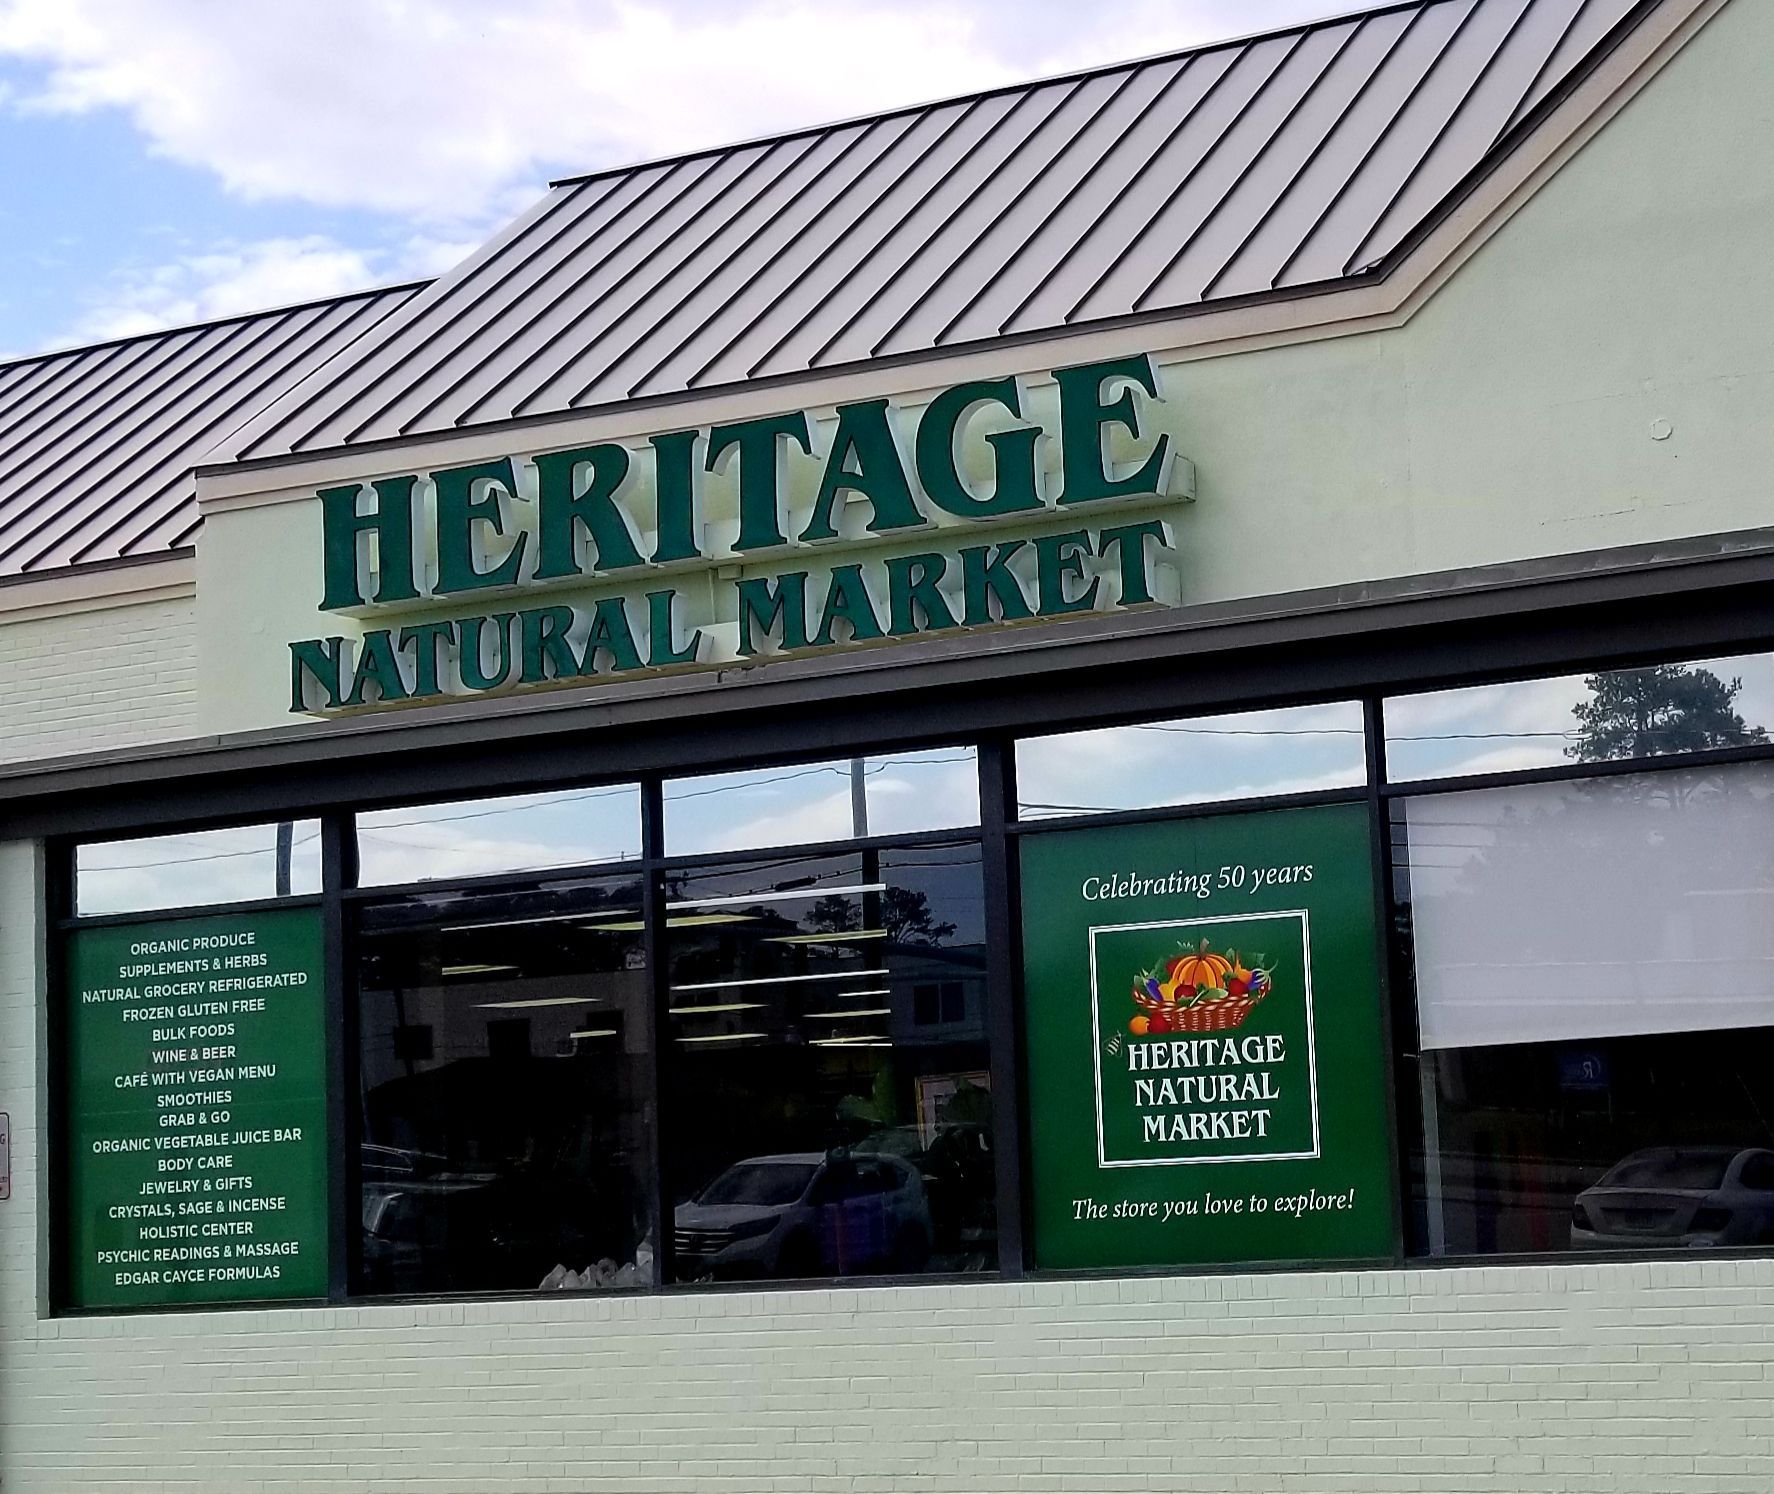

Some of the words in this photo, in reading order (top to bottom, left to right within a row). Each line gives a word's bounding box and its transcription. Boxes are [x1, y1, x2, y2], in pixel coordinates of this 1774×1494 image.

[315, 352, 1171, 613] HERITAGE
[288, 589, 703, 712] NATURAL
[735, 519, 1168, 657] MARKET
[1082, 870, 1212, 901] Celebrating
[1217, 864, 1246, 890] 50
[1250, 862, 1313, 894] years
[130, 940, 190, 955] ORGANIC
[193, 932, 256, 949] PRODUCE
[119, 960, 209, 978] SUPPLEMENTS
[212, 958, 221, 970] &
[224, 953, 267, 968] HERBS
[82, 987, 141, 1003] NATURAL
[144, 981, 205, 998] GROCERY
[209, 972, 307, 993] REFRIGERATED
[122, 1007, 174, 1022] FROZEN
[177, 1002, 228, 1018] GLUTEN
[232, 998, 266, 1014] FREE
[152, 1027, 186, 1041] BULK
[189, 1023, 235, 1039] FOODS
[152, 1049, 187, 1063] WINE
[190, 1048, 199, 1060] &
[202, 1046, 236, 1060] BEER
[1127, 1035, 1286, 1071] HERITAGE
[151, 1071, 185, 1086] WITH
[189, 1068, 234, 1083] VEGAN
[238, 1064, 276, 1080] MENU
[157, 1091, 232, 1107] SMOOTHIES
[1134, 1072, 1280, 1107] NATURAL
[159, 1113, 195, 1127] GRAB
[198, 1112, 207, 1124] &
[210, 1110, 230, 1124] GO
[1143, 1109, 1271, 1143] MARKET
[92, 1137, 151, 1154] ORGANIC
[154, 1133, 229, 1150] VEGETABLE
[232, 1129, 270, 1145] JUICE
[273, 1128, 302, 1142] BAR
[157, 1157, 193, 1172] BODY
[197, 1155, 233, 1170] CARE
[139, 1180, 200, 1195] JEWELRY
[203, 1179, 212, 1191] &
[215, 1176, 252, 1191] GIFTS
[108, 1203, 175, 1219] CRYSTALS,
[178, 1201, 213, 1216] SAGE
[216, 1201, 225, 1213] &
[228, 1197, 286, 1213] INCENSE
[1072, 1199, 1108, 1220] The
[1113, 1198, 1158, 1218] store
[1161, 1199, 1199, 1222] you
[1204, 1192, 1243, 1214] love
[1249, 1194, 1268, 1213] to
[1274, 1188, 1355, 1220] explore!
[139, 1224, 198, 1240] HOLISTIC
[201, 1222, 253, 1237] CENTER
[97, 1248, 150, 1264] PSYCHIC
[153, 1245, 220, 1262] READINGS
[223, 1245, 233, 1257] &
[235, 1241, 299, 1258] MASSAGE
[115, 1271, 160, 1286] EDGAR
[162, 1268, 205, 1284] CAYCE
[208, 1265, 280, 1282] FORMULAS
